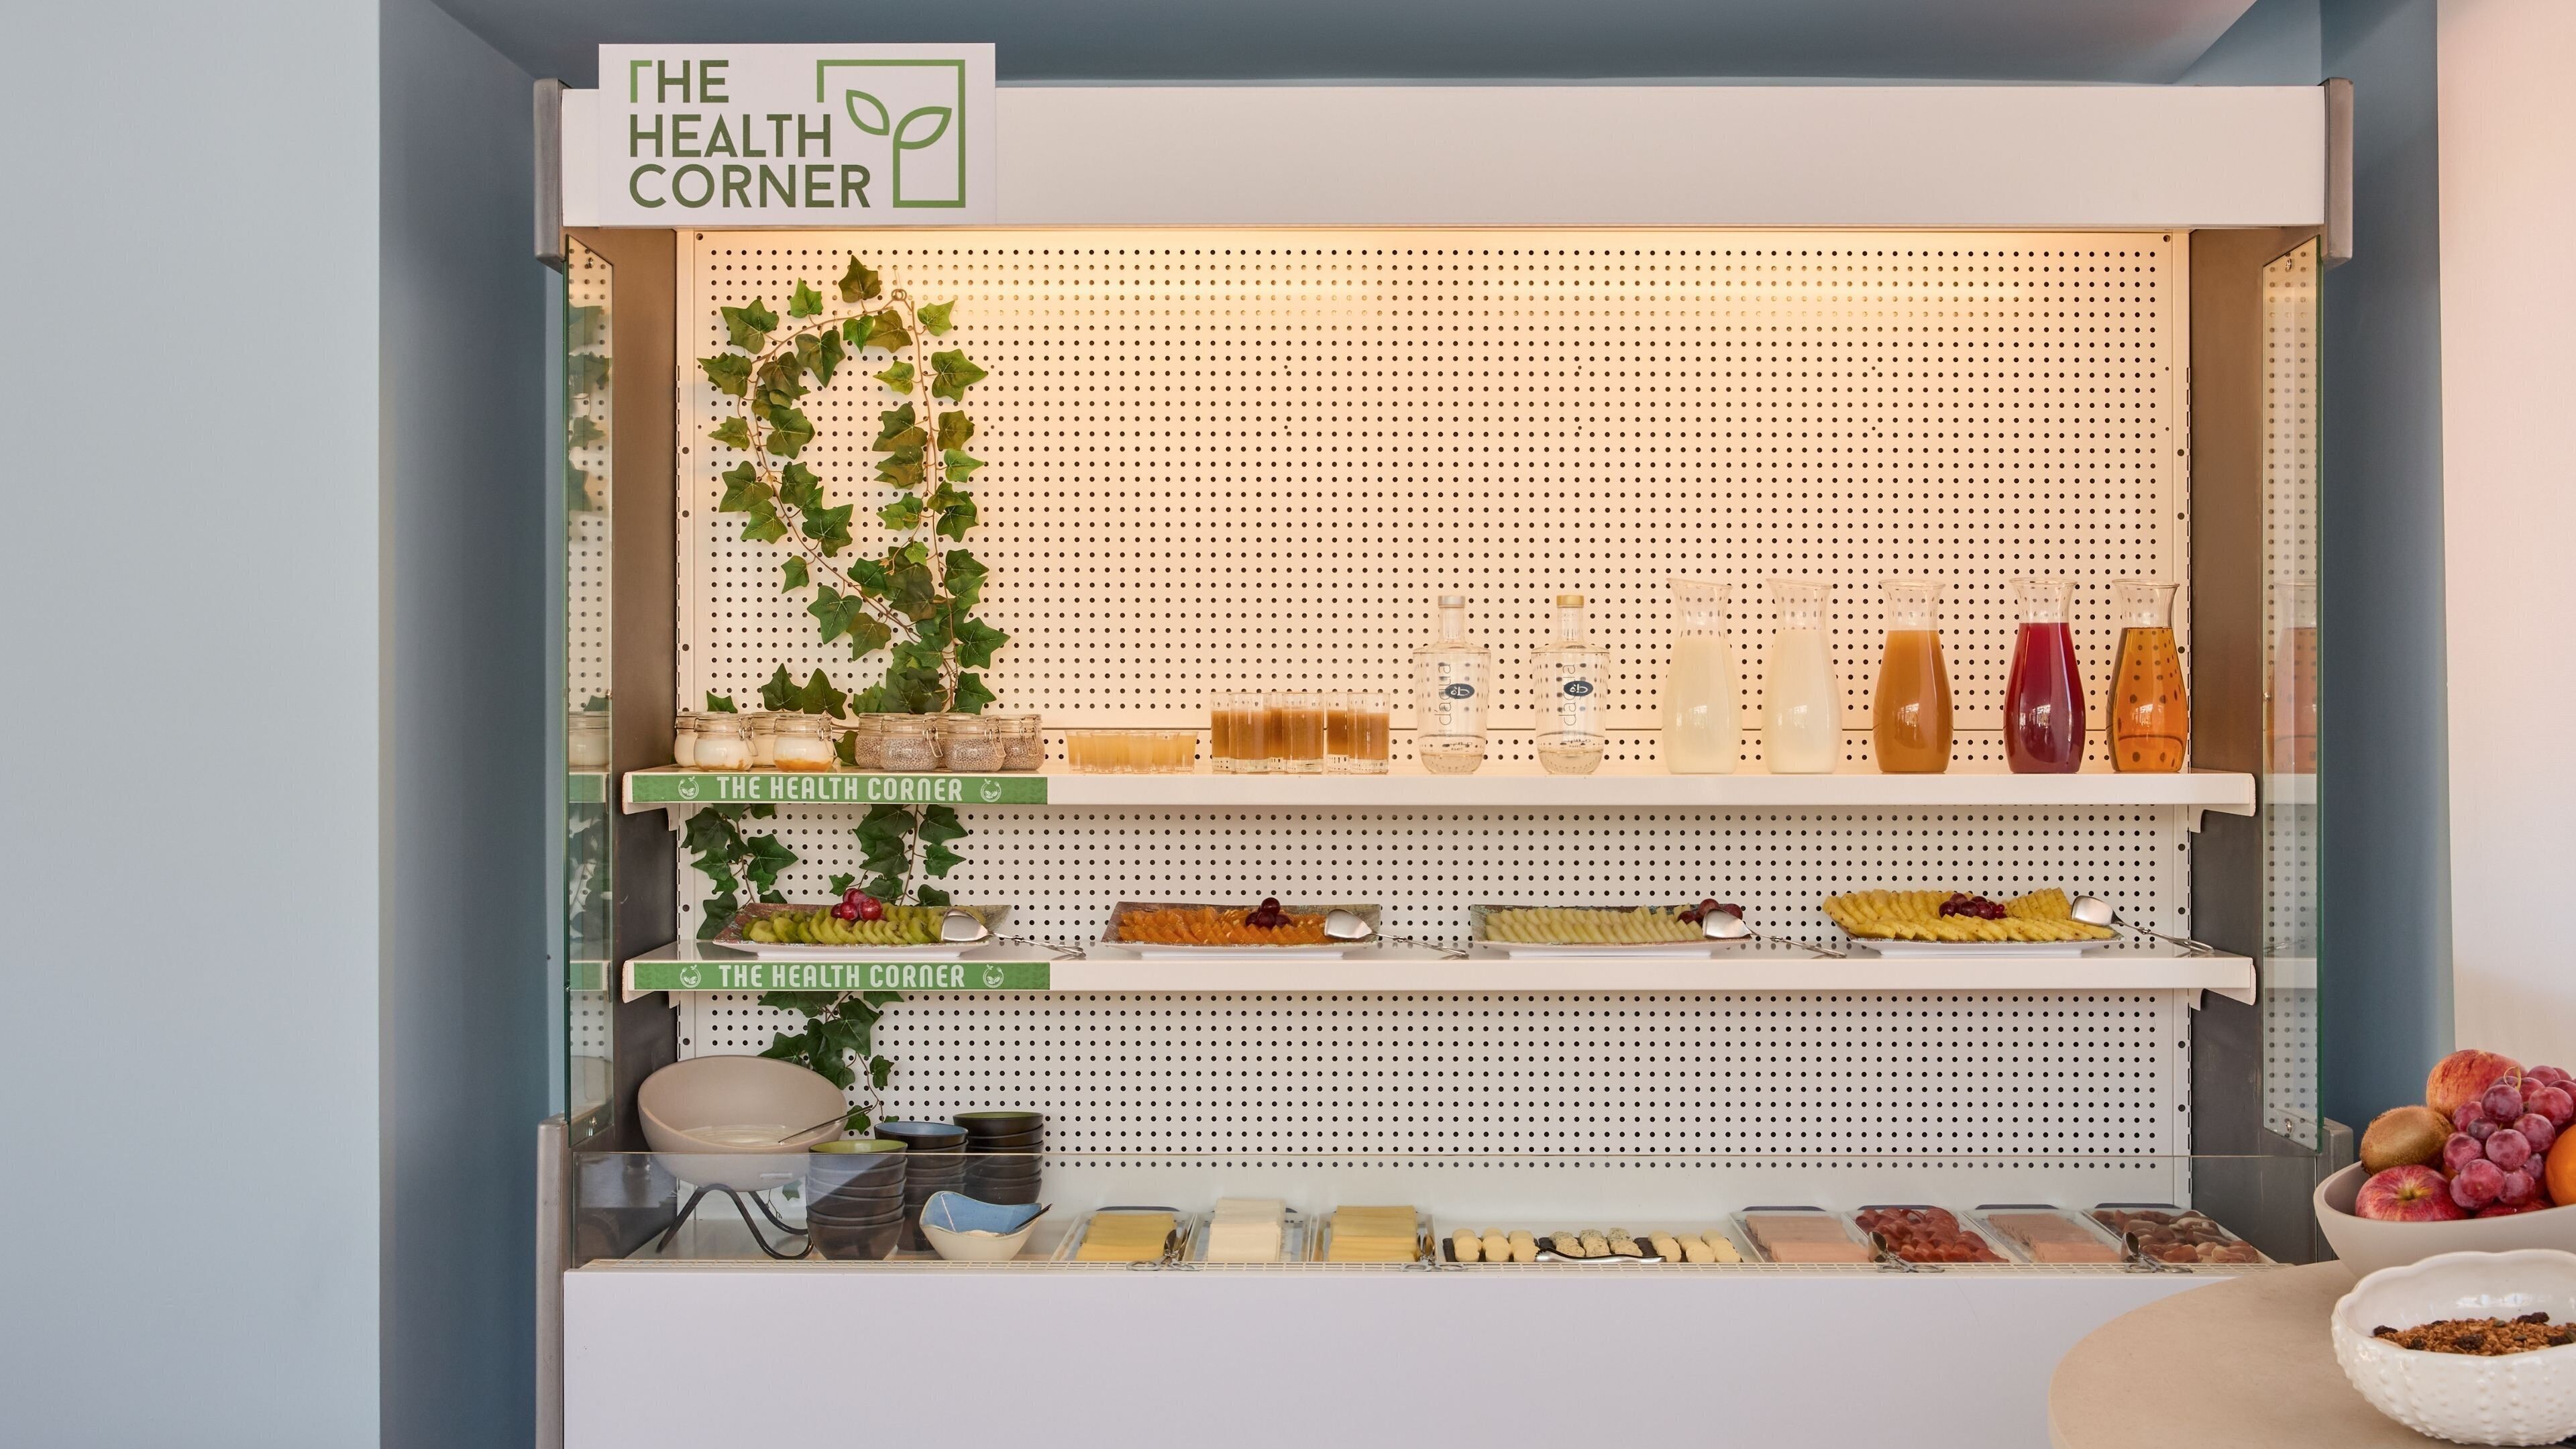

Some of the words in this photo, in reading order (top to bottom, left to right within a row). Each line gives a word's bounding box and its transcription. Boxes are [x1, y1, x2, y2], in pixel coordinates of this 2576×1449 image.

[630, 60, 729, 103] THE
[630, 113, 831, 157] HEALTH
[629, 163, 871, 208] CORNER
[716, 776, 761, 799] THE
[771, 776, 857, 800] HEALTH
[867, 777, 963, 801] CORNER
[718, 965, 763, 987] THE
[772, 965, 860, 987] HEALTH
[869, 965, 965, 988] CORNER
